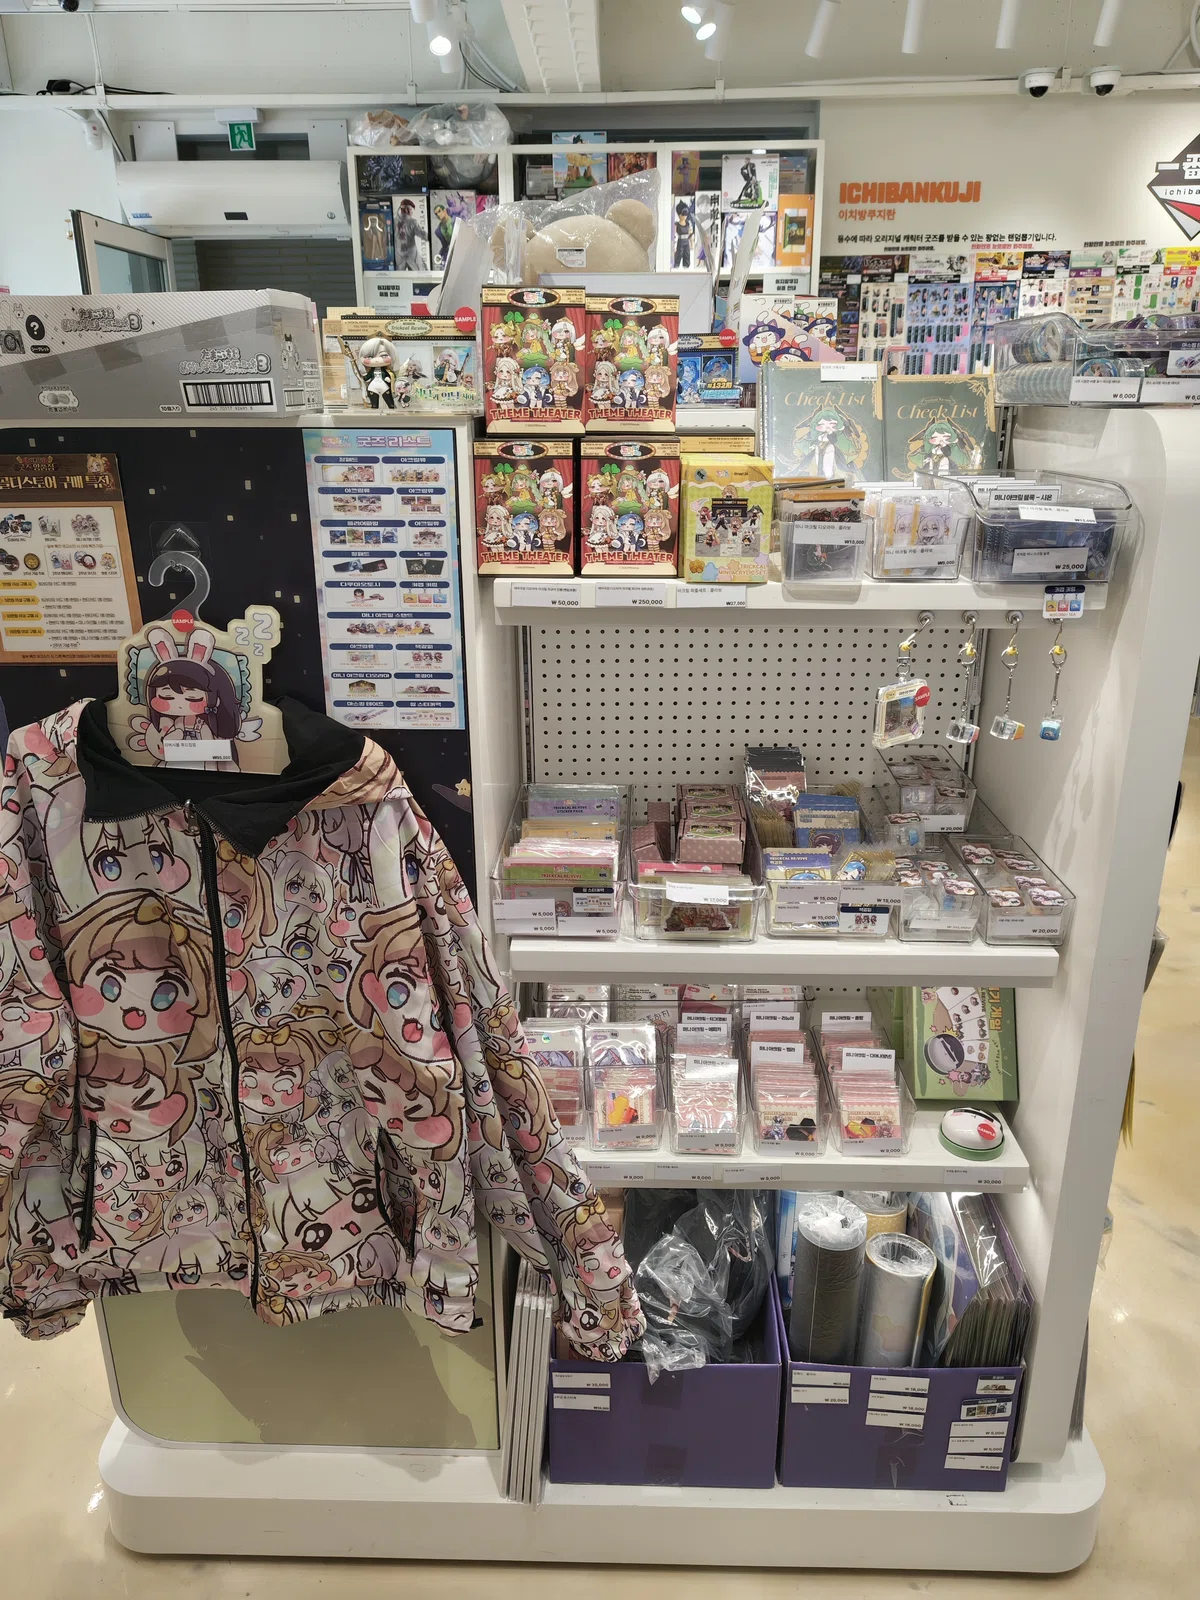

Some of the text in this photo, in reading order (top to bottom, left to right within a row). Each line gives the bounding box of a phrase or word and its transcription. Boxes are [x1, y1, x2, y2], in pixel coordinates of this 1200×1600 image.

[839, 181, 982, 204] ICHIBANKUJI
[838, 208, 896, 221] 이치방쿠지란
[838, 235, 857, 243] 등수에
[859, 235, 872, 243] 따라
[874, 234, 900, 243] 오리지널
[902, 234, 923, 242] 캐릭터
[1008, 233, 1056, 242] 랜덤뽑기입니다.
[784, 391, 866, 406] Check List
[490, 408, 582, 420] THEME THEATER
[588, 408, 672, 419] THEME THEATER
[896, 404, 978, 420] Check List
[357, 436, 432, 448] 굿즈 리스트
[59, 475, 84, 488] 구매
[85, 475, 110, 488] 특전
[482, 551, 570, 562] THEME THEATER
[585, 552, 674, 562] THEME THEATER
